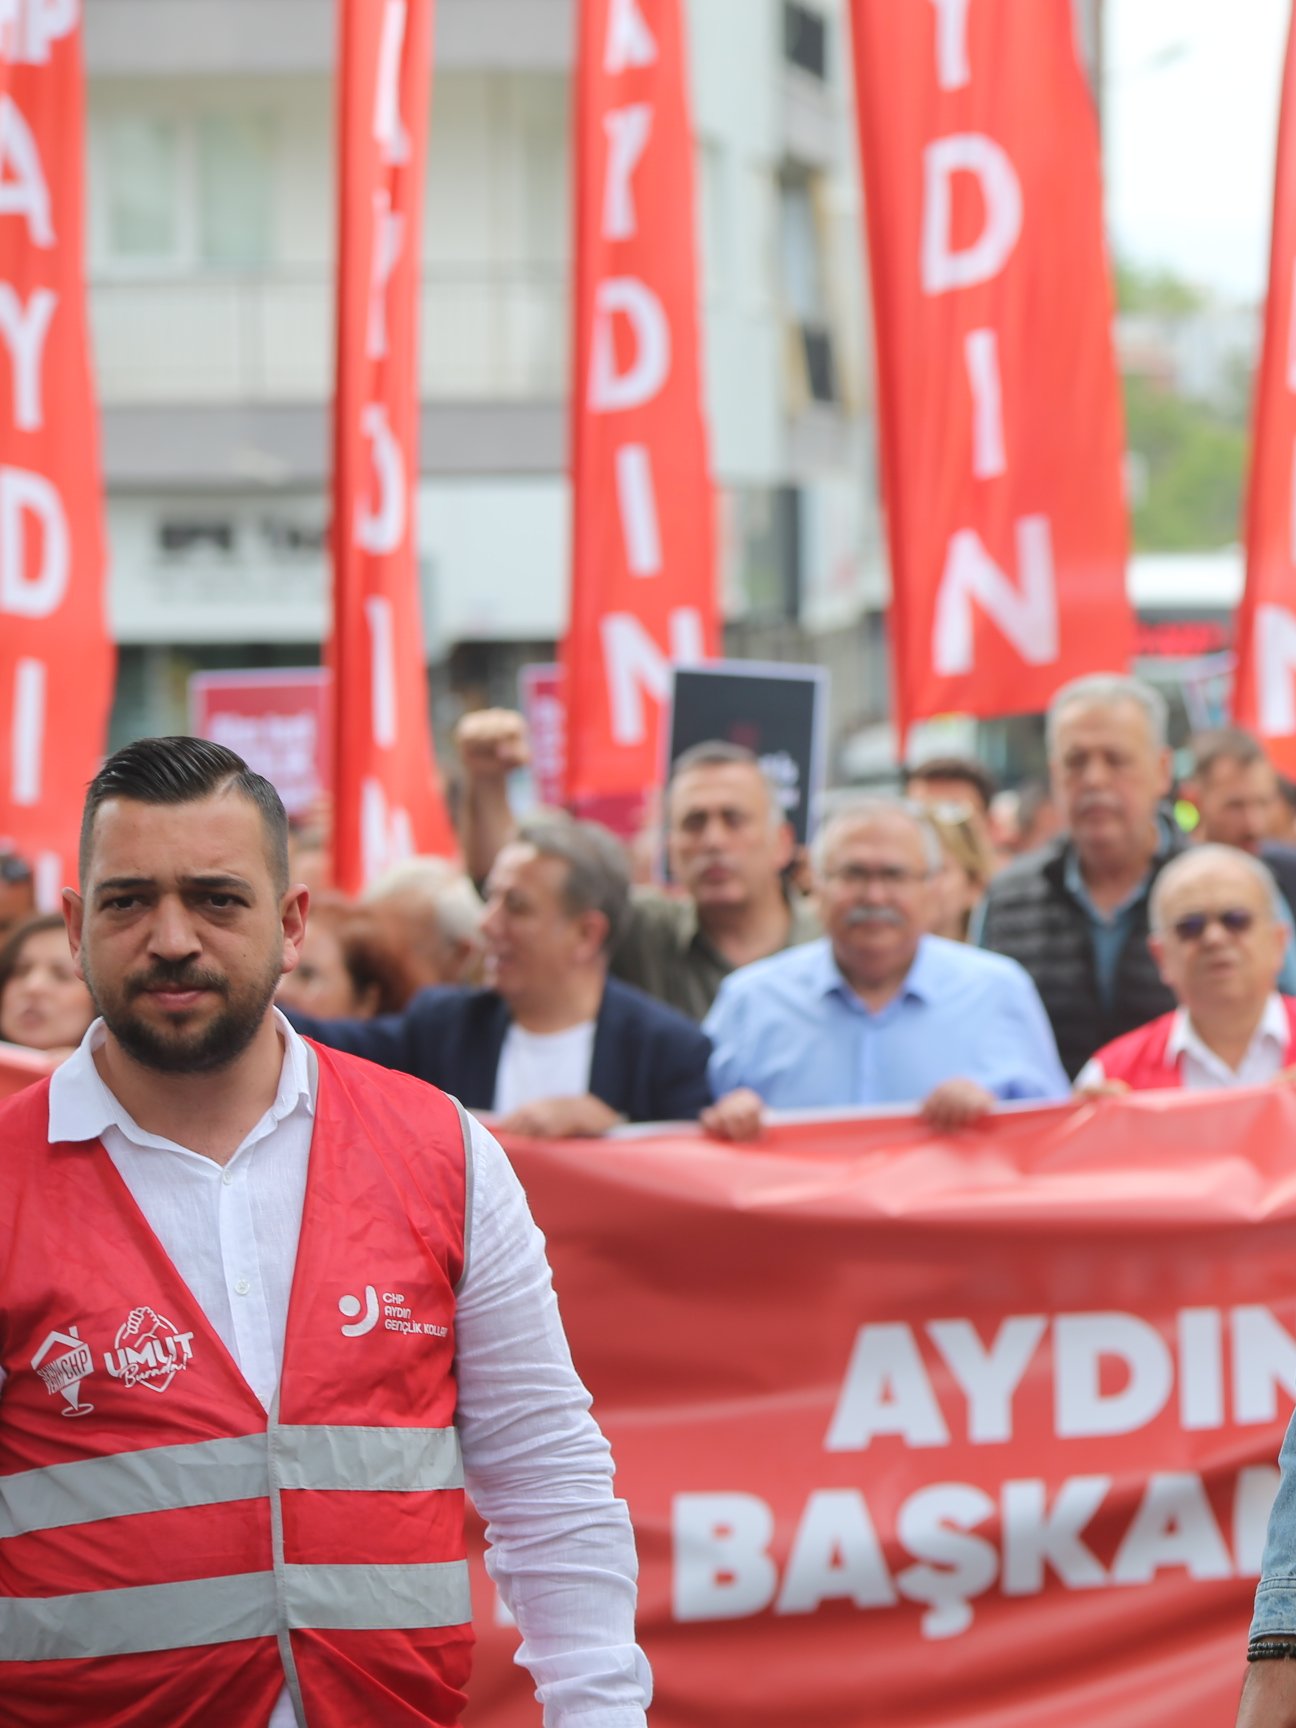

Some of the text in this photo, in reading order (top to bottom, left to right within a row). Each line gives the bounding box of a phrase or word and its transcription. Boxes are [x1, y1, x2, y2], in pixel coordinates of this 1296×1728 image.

[382, 1292, 405, 1304] CHP
[385, 1319, 423, 1335] GENÇLİK
[60, 1349, 88, 1380] CHP
[103, 1332, 194, 1377] UMUT
